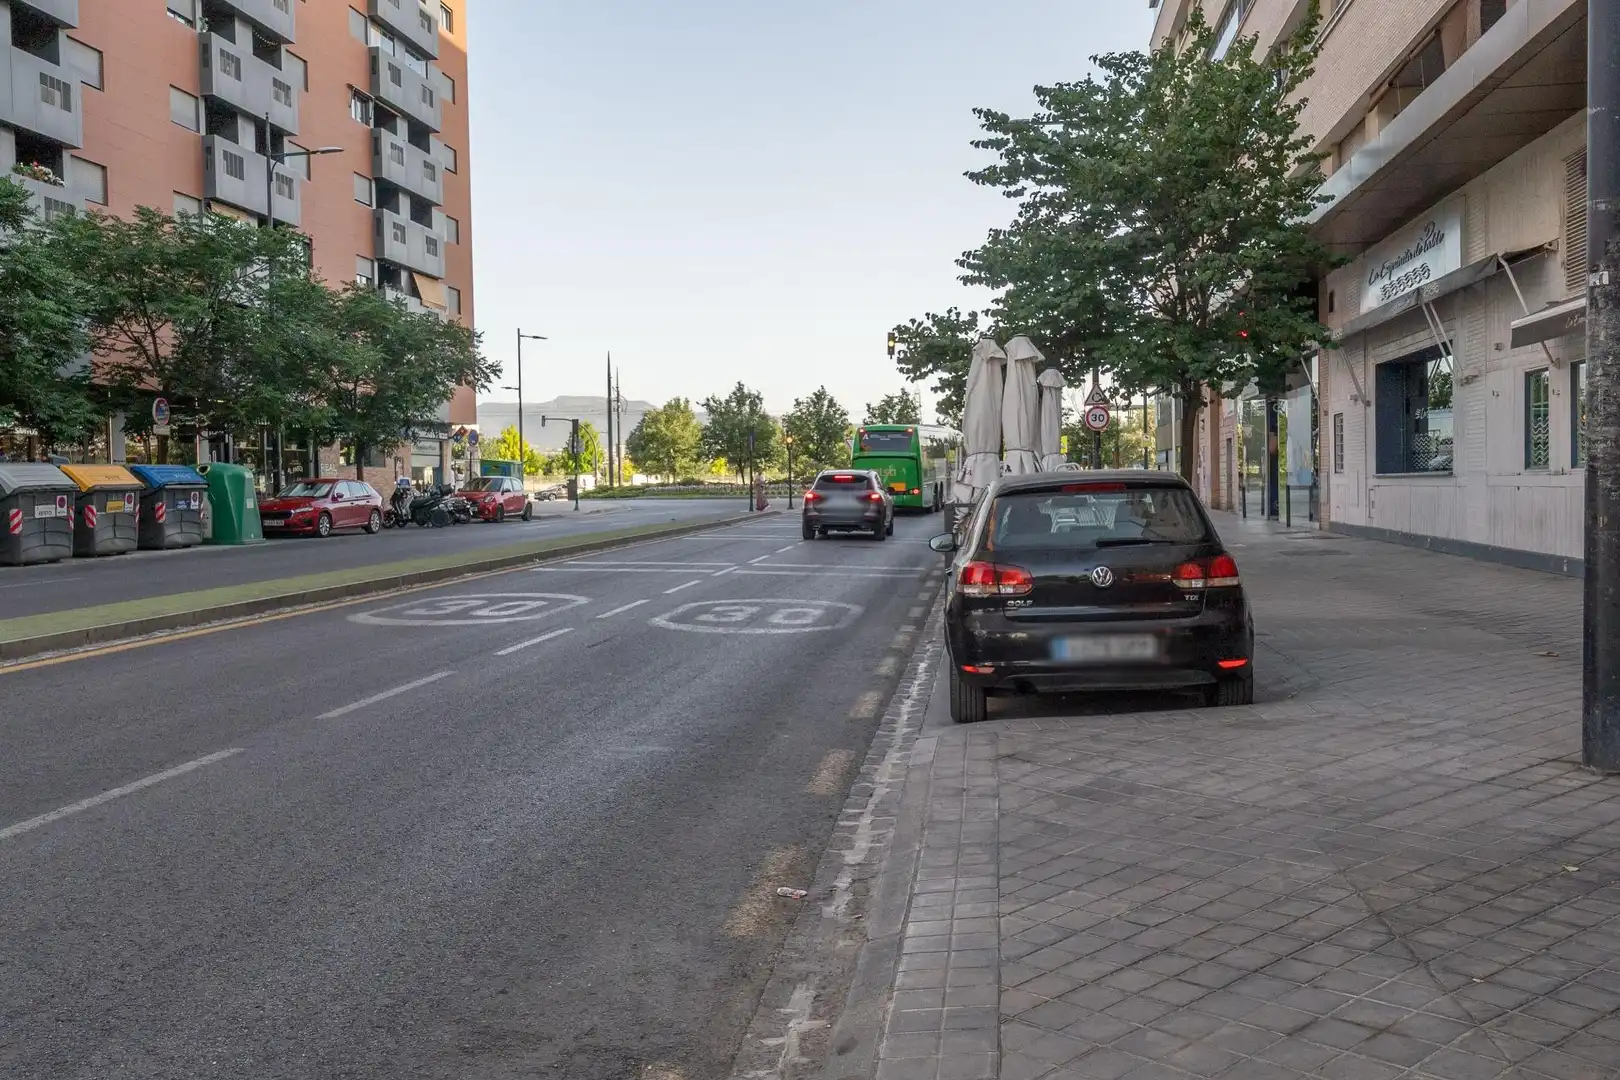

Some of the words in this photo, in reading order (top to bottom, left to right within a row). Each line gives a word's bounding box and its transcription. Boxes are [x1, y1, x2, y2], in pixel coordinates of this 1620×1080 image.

[1091, 413, 1105, 422] 30
[403, 599, 549, 616] 30
[699, 605, 820, 625] 30
